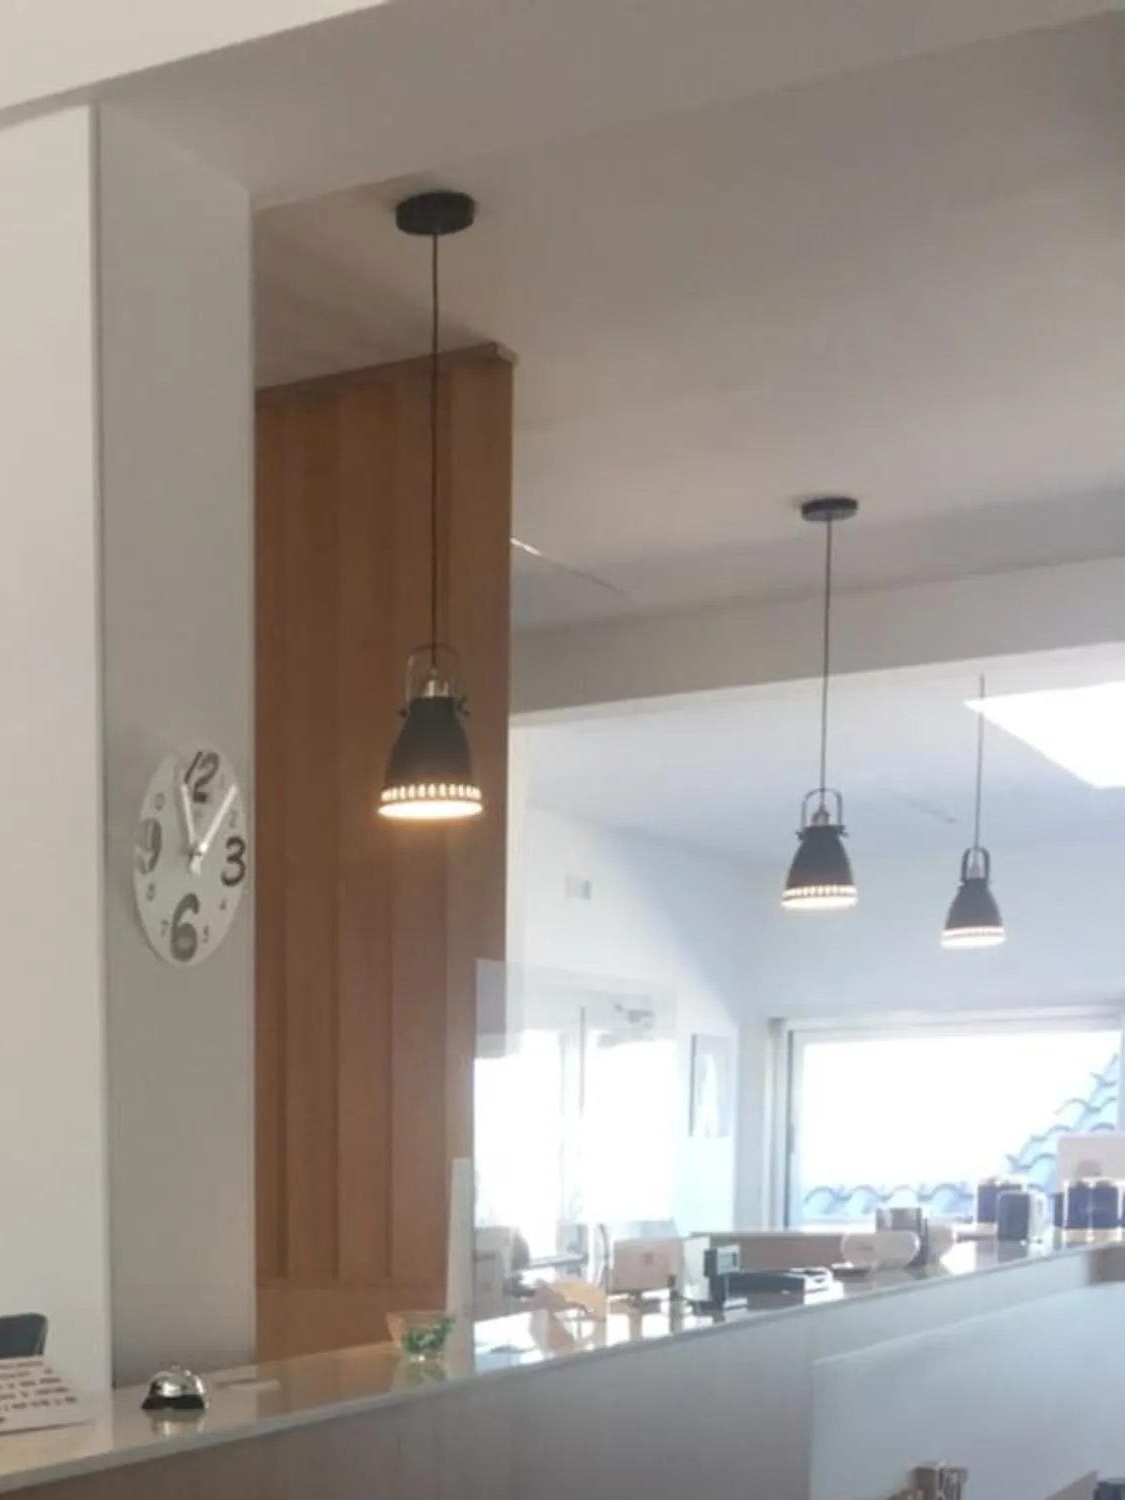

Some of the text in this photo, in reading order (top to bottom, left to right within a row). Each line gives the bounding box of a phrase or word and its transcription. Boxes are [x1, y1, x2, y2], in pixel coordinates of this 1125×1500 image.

[184, 751, 220, 804] 12
[221, 836, 246, 887] 3
[170, 892, 200, 962] 6
